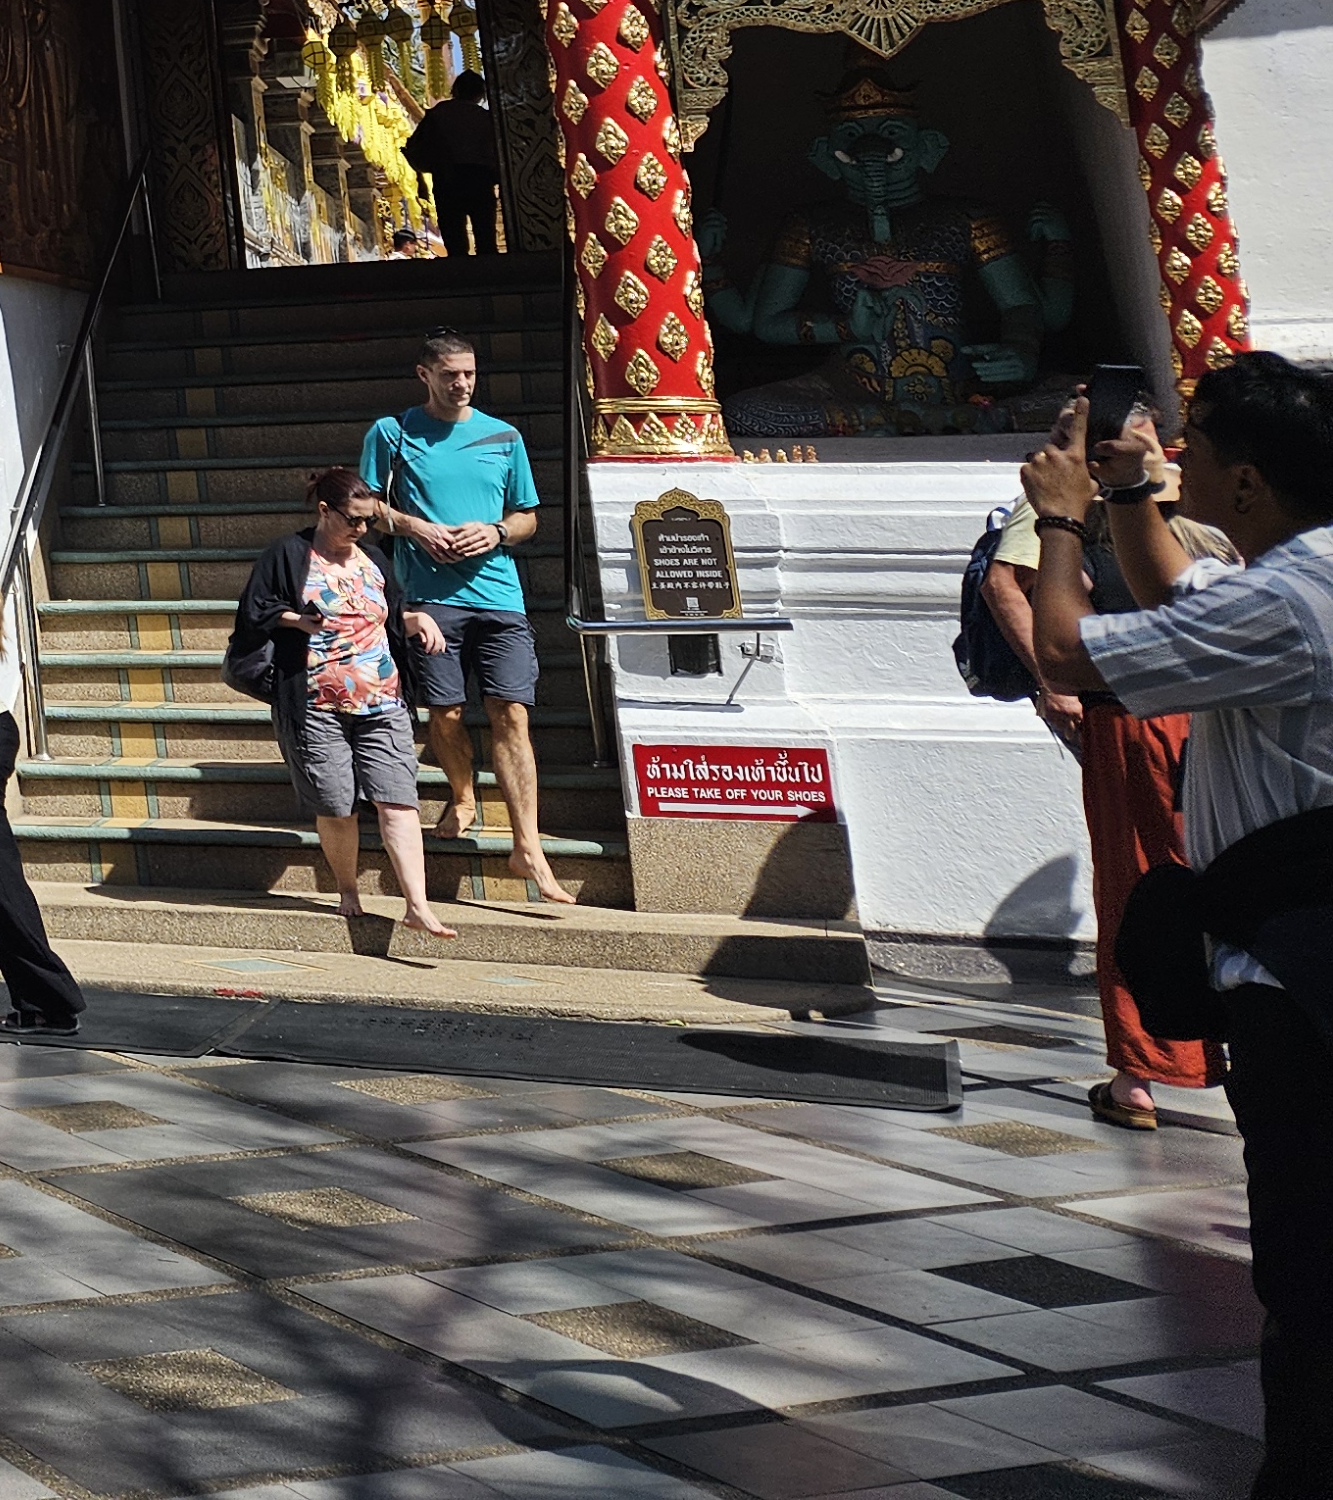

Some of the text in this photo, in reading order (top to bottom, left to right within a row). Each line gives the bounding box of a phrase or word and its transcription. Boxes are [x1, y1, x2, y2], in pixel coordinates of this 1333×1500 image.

[653, 558, 717, 566] SHOES ARE NOT
[655, 570, 722, 578] ALLOWED INSIDE
[646, 750, 823, 783] ห้ามใส่รองเท้าขึ้นไป
[647, 787, 826, 802] PLEASE TAKE OFF YOUR SHOES
